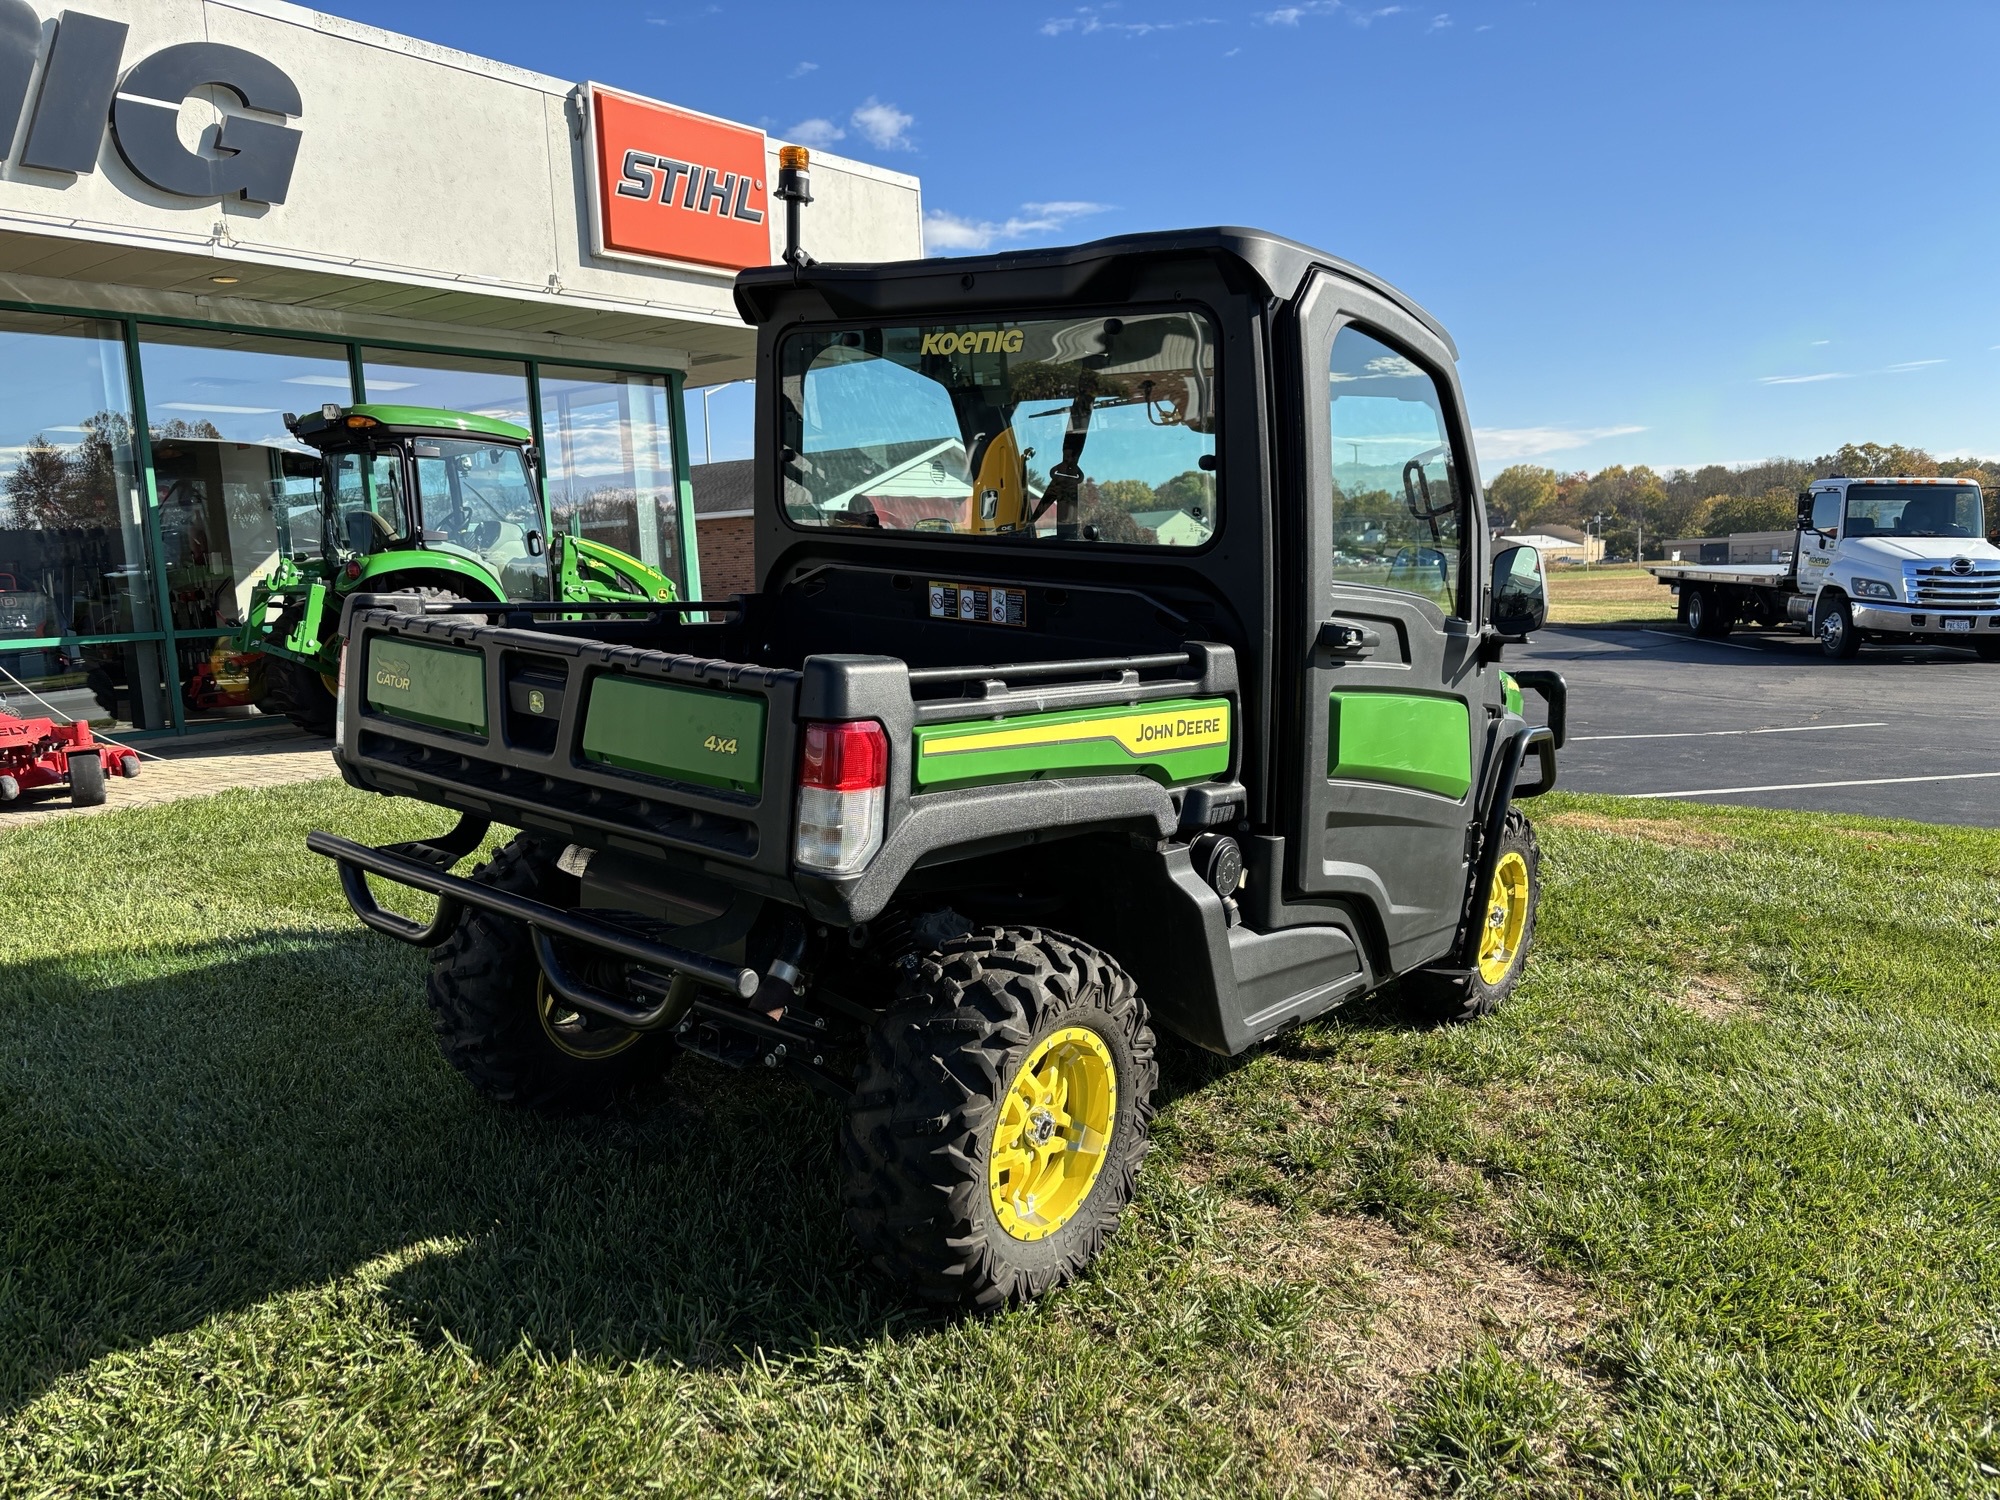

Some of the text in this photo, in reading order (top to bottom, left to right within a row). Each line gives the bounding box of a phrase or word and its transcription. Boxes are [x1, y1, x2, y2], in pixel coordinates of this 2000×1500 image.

[0, 0, 303, 206] IG
[615, 149, 765, 225] STIHL
[376, 670, 411, 691] GATOR
[1136, 717, 1221, 742] JOHN DEERE
